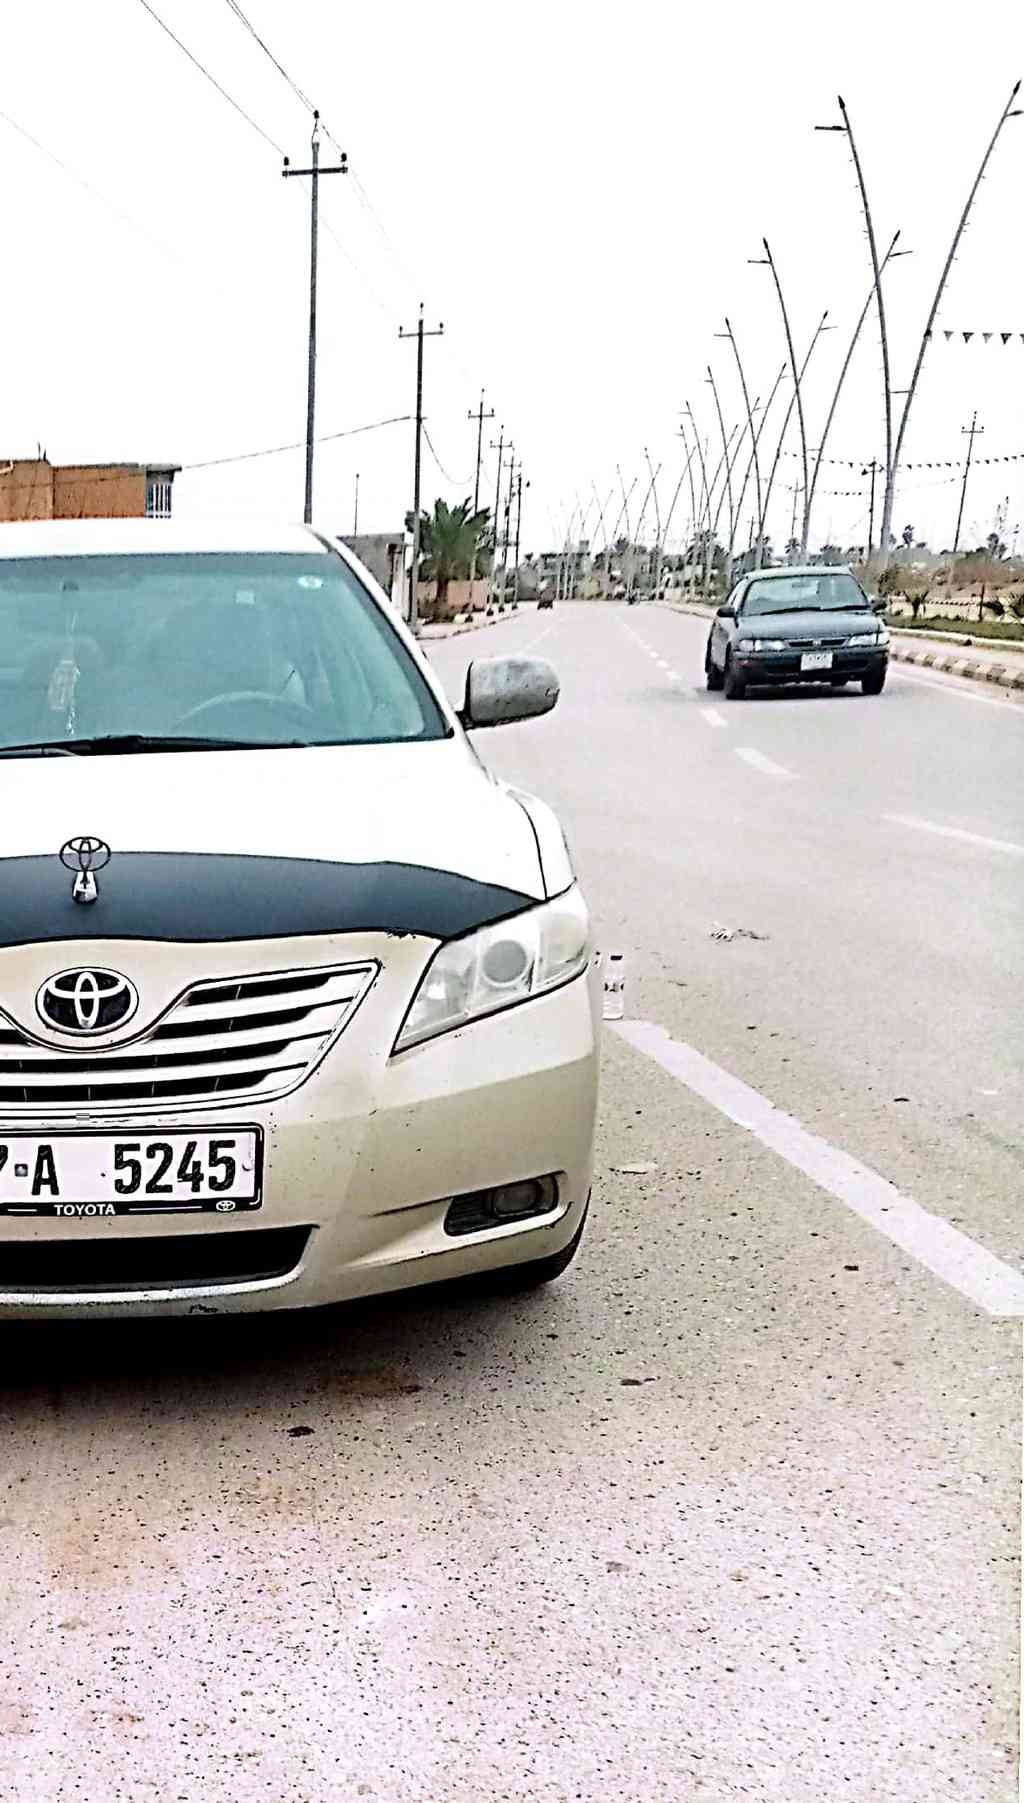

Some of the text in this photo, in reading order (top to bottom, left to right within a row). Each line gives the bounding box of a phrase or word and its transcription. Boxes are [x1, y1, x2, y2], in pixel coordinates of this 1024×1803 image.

[31, 1145, 60, 1196] A
[114, 1140, 237, 1194] 5245
[53, 1203, 116, 1216] TOYOTA
